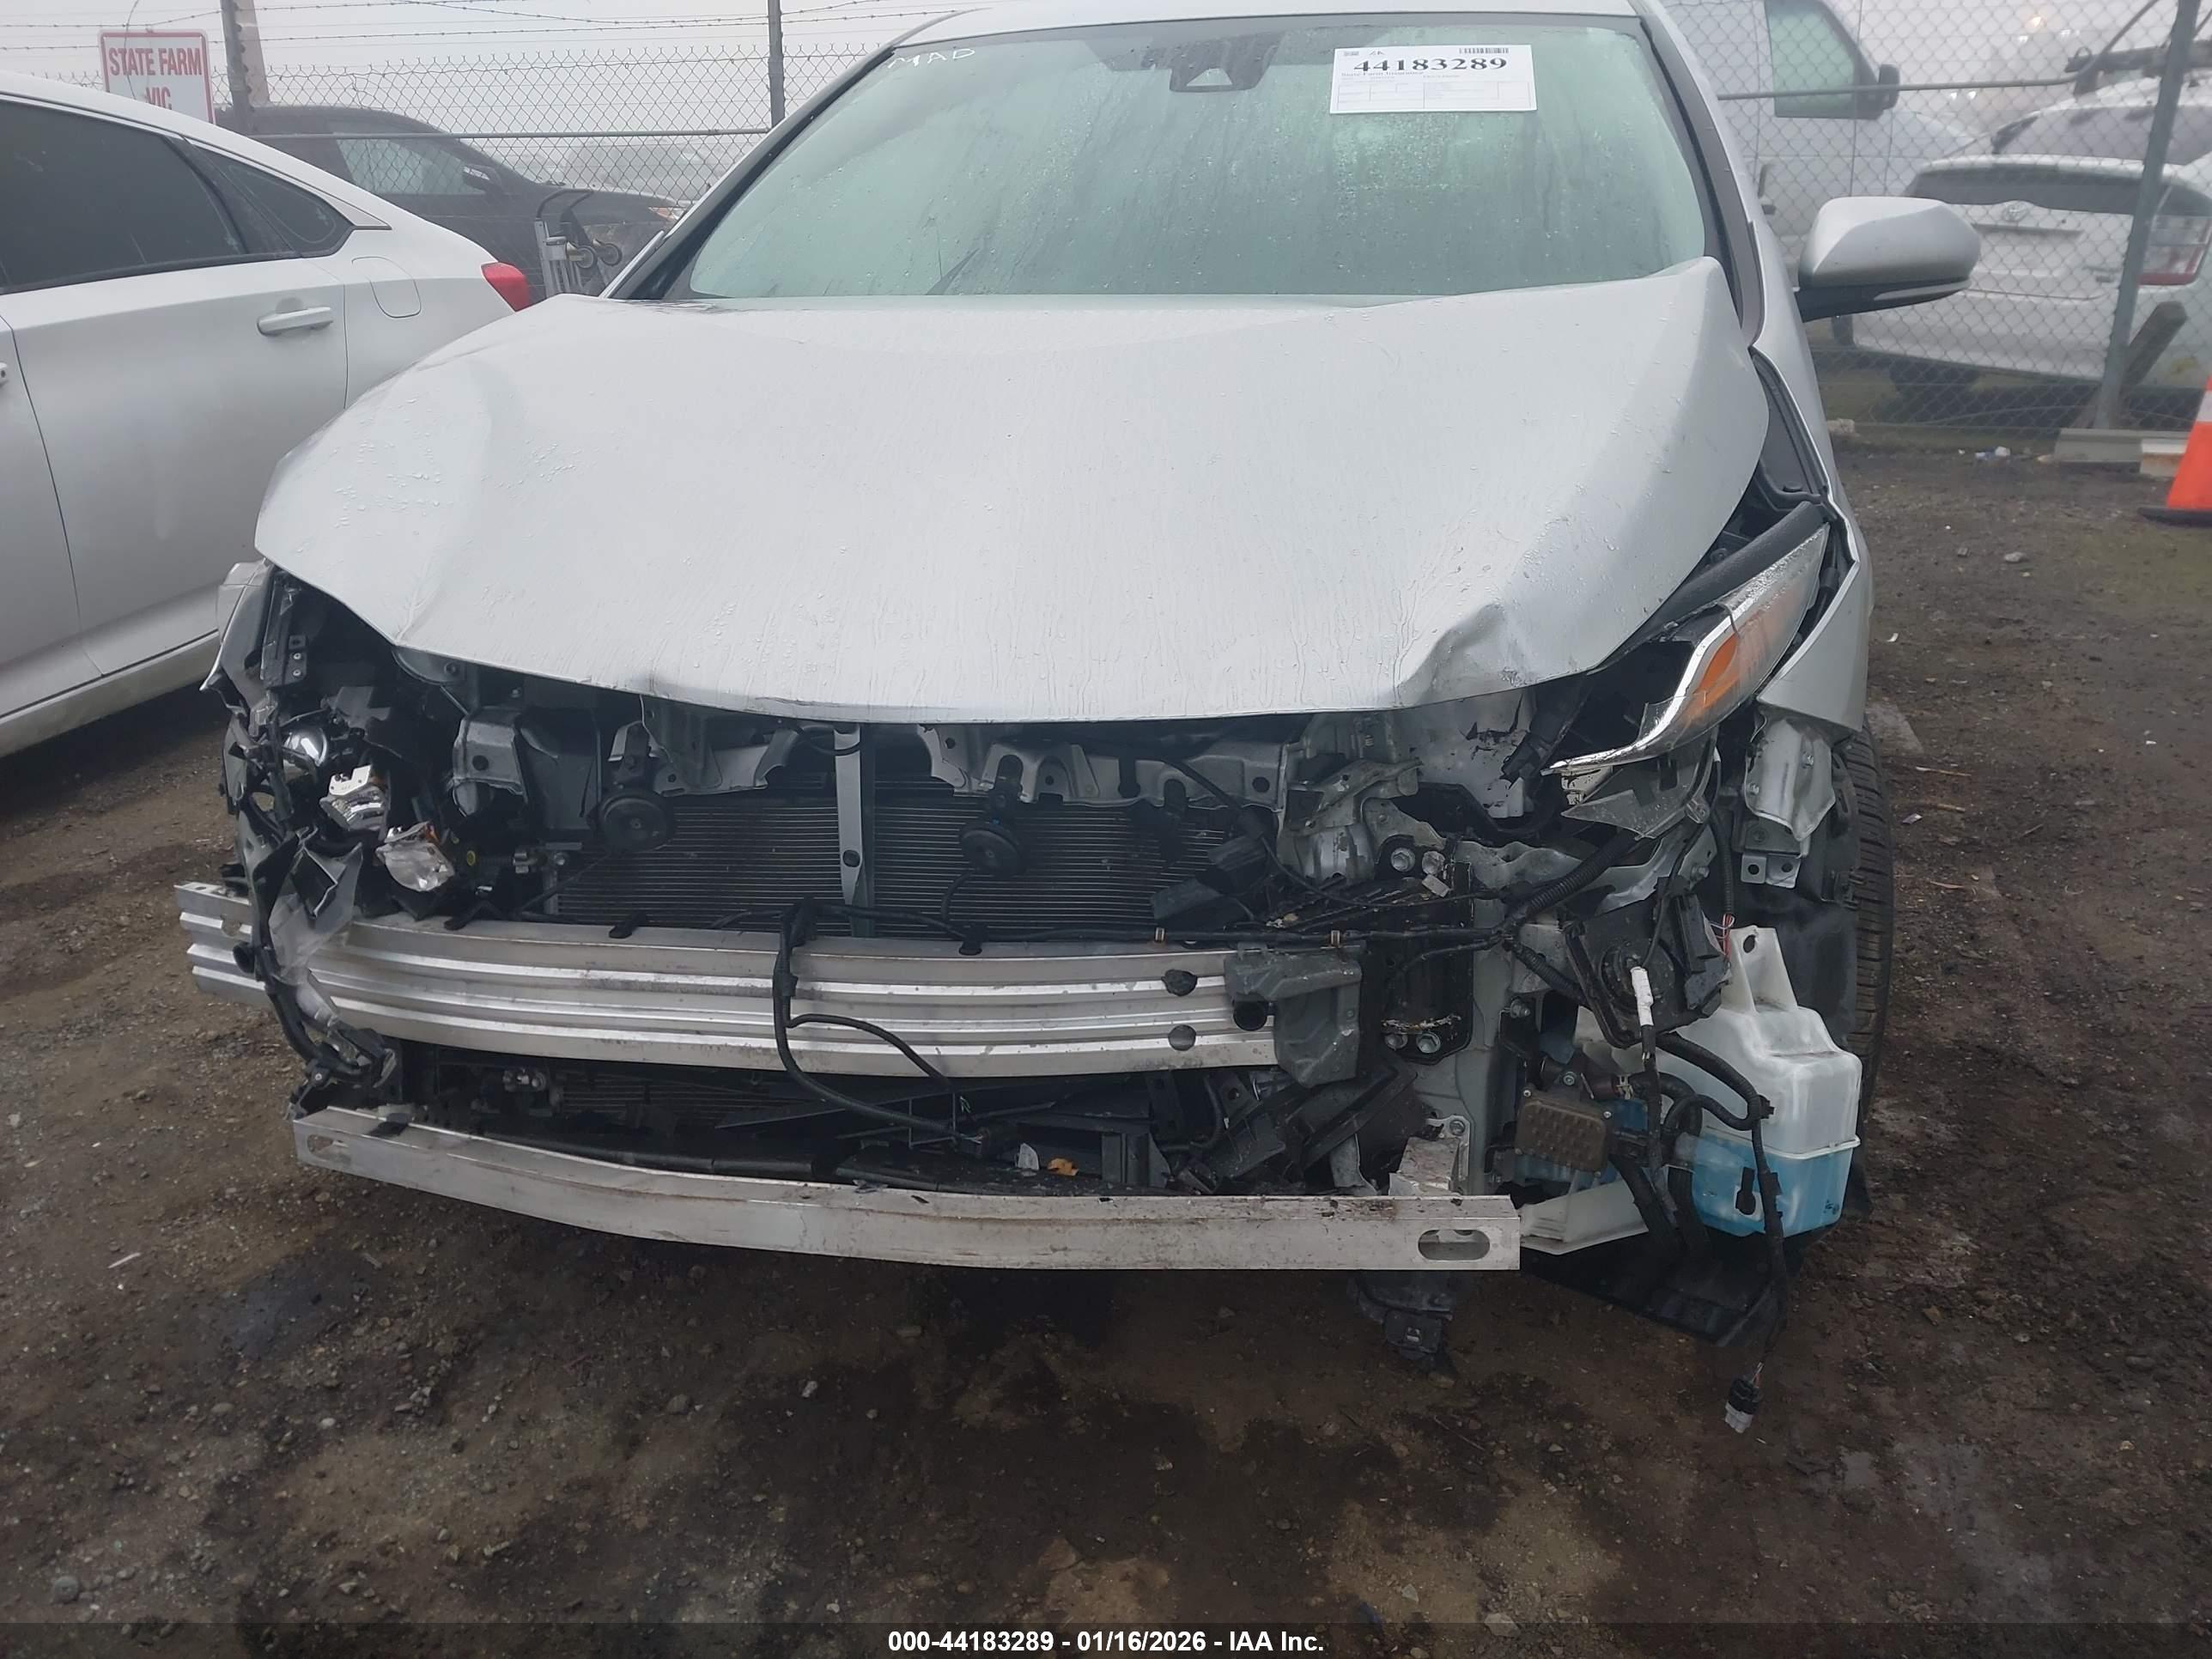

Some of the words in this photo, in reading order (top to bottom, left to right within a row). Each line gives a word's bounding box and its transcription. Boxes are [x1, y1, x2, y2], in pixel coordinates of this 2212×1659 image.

[108, 47, 156, 76] STATE
[158, 47, 203, 76] FARM
[1354, 58, 1508, 72] 44183289
